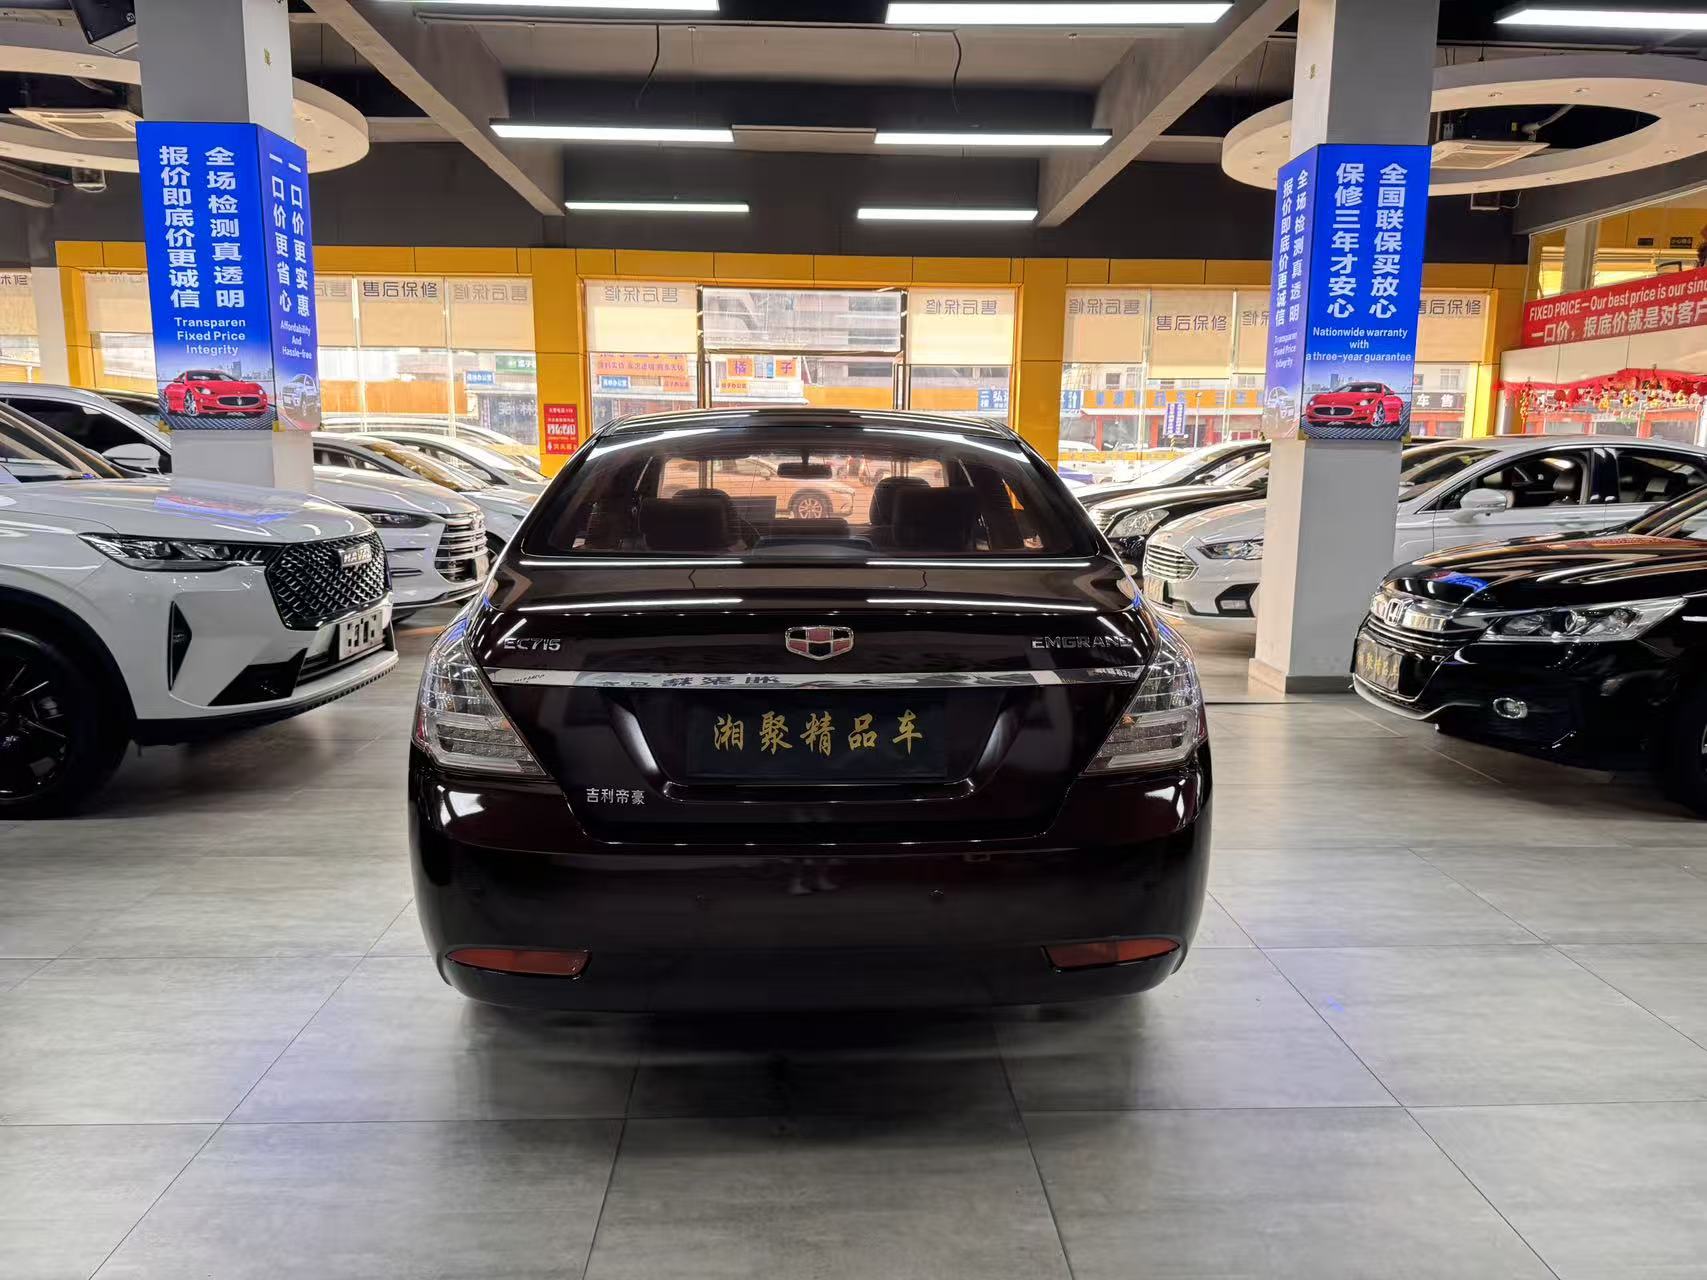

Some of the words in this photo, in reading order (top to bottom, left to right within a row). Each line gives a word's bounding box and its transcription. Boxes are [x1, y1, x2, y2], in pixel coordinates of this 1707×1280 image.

[159, 146, 201, 308] 报价即底价更诚信
[205, 146, 246, 308] 全场检测真透明
[269, 152, 292, 313] 一口价更省心
[288, 155, 311, 317] 一口价更实惠
[1326, 163, 1365, 319] 保修三年才安心
[1368, 163, 1408, 319] 全国联保买放心
[363, 281, 438, 299] 售后保修
[1529, 304, 1553, 322] FIXED
[1608, 290, 1628, 308] best
[1630, 287, 1656, 308] price
[1657, 283, 1666, 300] is
[1668, 282, 1687, 298] our
[1155, 315, 1228, 332] 售后保修
[177, 330, 211, 341] Fixed
[213, 330, 246, 341] Price
[1312, 327, 1365, 337] Nationwide
[1366, 327, 1408, 339] warranty
[186, 344, 239, 357] Integrity
[1349, 339, 1370, 349] with
[1305, 353, 1312, 361] a
[1313, 351, 1363, 363] three-year
[1364, 353, 1412, 362] guarantee
[503, 638, 561, 652] EC715
[1031, 636, 1133, 650] EMGRAND
[713, 709, 923, 757] 湘聚精品车
[586, 787, 646, 806] 吉利帝豪
